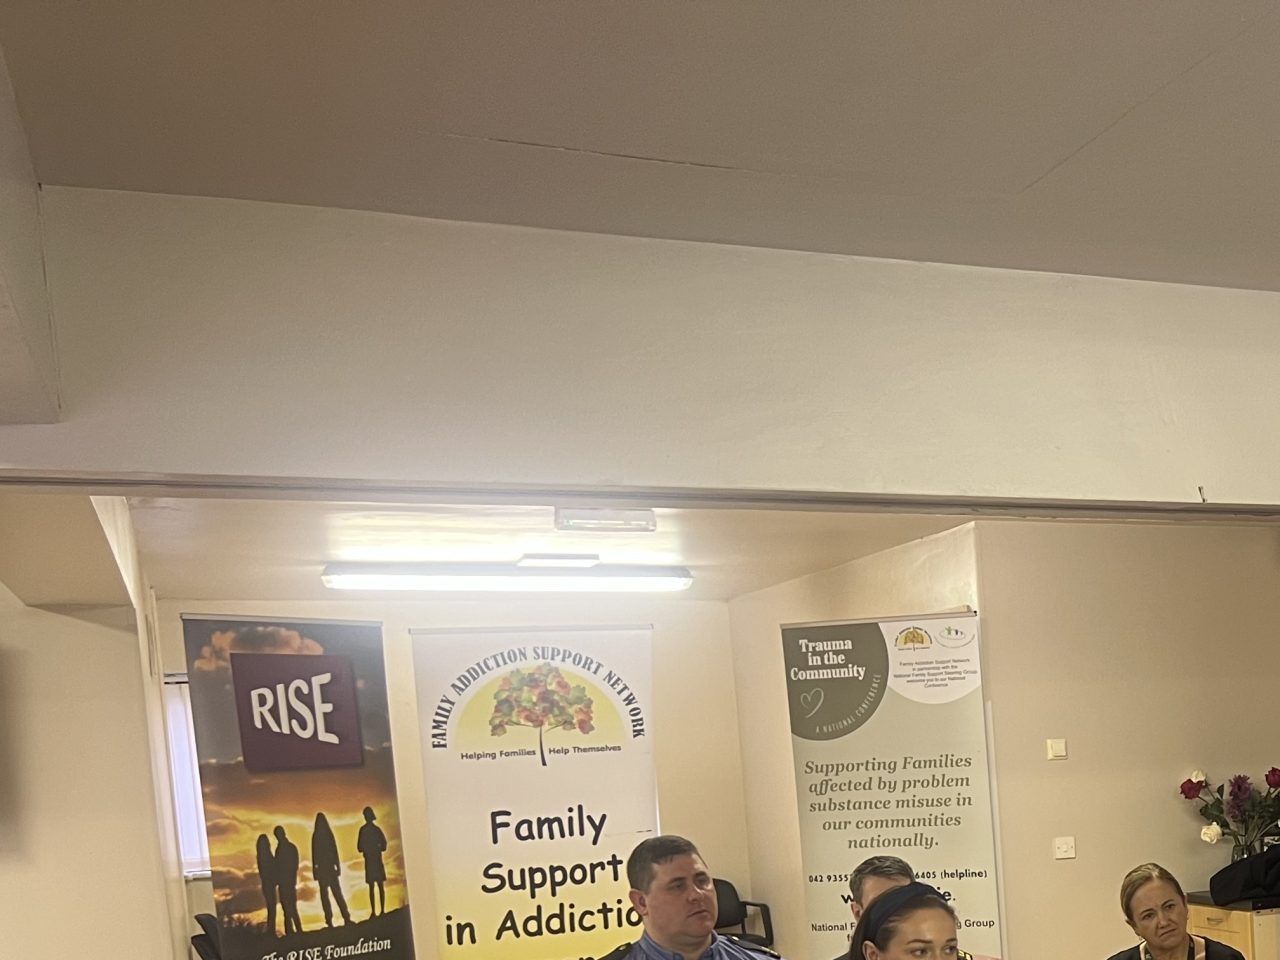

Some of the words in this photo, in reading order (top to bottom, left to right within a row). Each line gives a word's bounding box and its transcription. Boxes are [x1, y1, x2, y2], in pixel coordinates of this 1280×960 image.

[798, 638, 853, 652] Trauma
[808, 652, 822, 666] in
[823, 651, 846, 665] the
[790, 663, 866, 681] Community
[431, 693, 456, 749] FAMILY
[450, 646, 528, 696] ADDICTION
[533, 645, 604, 676] SUPPORT
[602, 669, 646, 739] NETWORK
[250, 672, 340, 744] RISE
[460, 750, 497, 761] Helping
[499, 748, 537, 758] Families
[548, 746, 570, 756] Help
[572, 744, 622, 754] Themselves
[804, 757, 898, 777] Supporting
[901, 753, 973, 770] Families
[808, 776, 873, 796] affected
[877, 776, 898, 793] by
[901, 773, 971, 793] problem
[809, 797, 892, 813] substance
[895, 794, 952, 809] misuse
[956, 792, 973, 807] in
[490, 804, 608, 846] Family
[822, 819, 851, 831] our
[855, 812, 962, 830] communities
[847, 833, 939, 850] nationally.
[481, 853, 624, 900] Support
[808, 873, 824, 883] 042
[826, 873, 850, 883] 9355
[940, 868, 988, 881] (helpline)
[445, 914, 477, 946] in
[495, 898, 643, 941] Addictio
[811, 922, 848, 932] National
[964, 918, 995, 929] Group
[325, 937, 392, 960] Foundation
